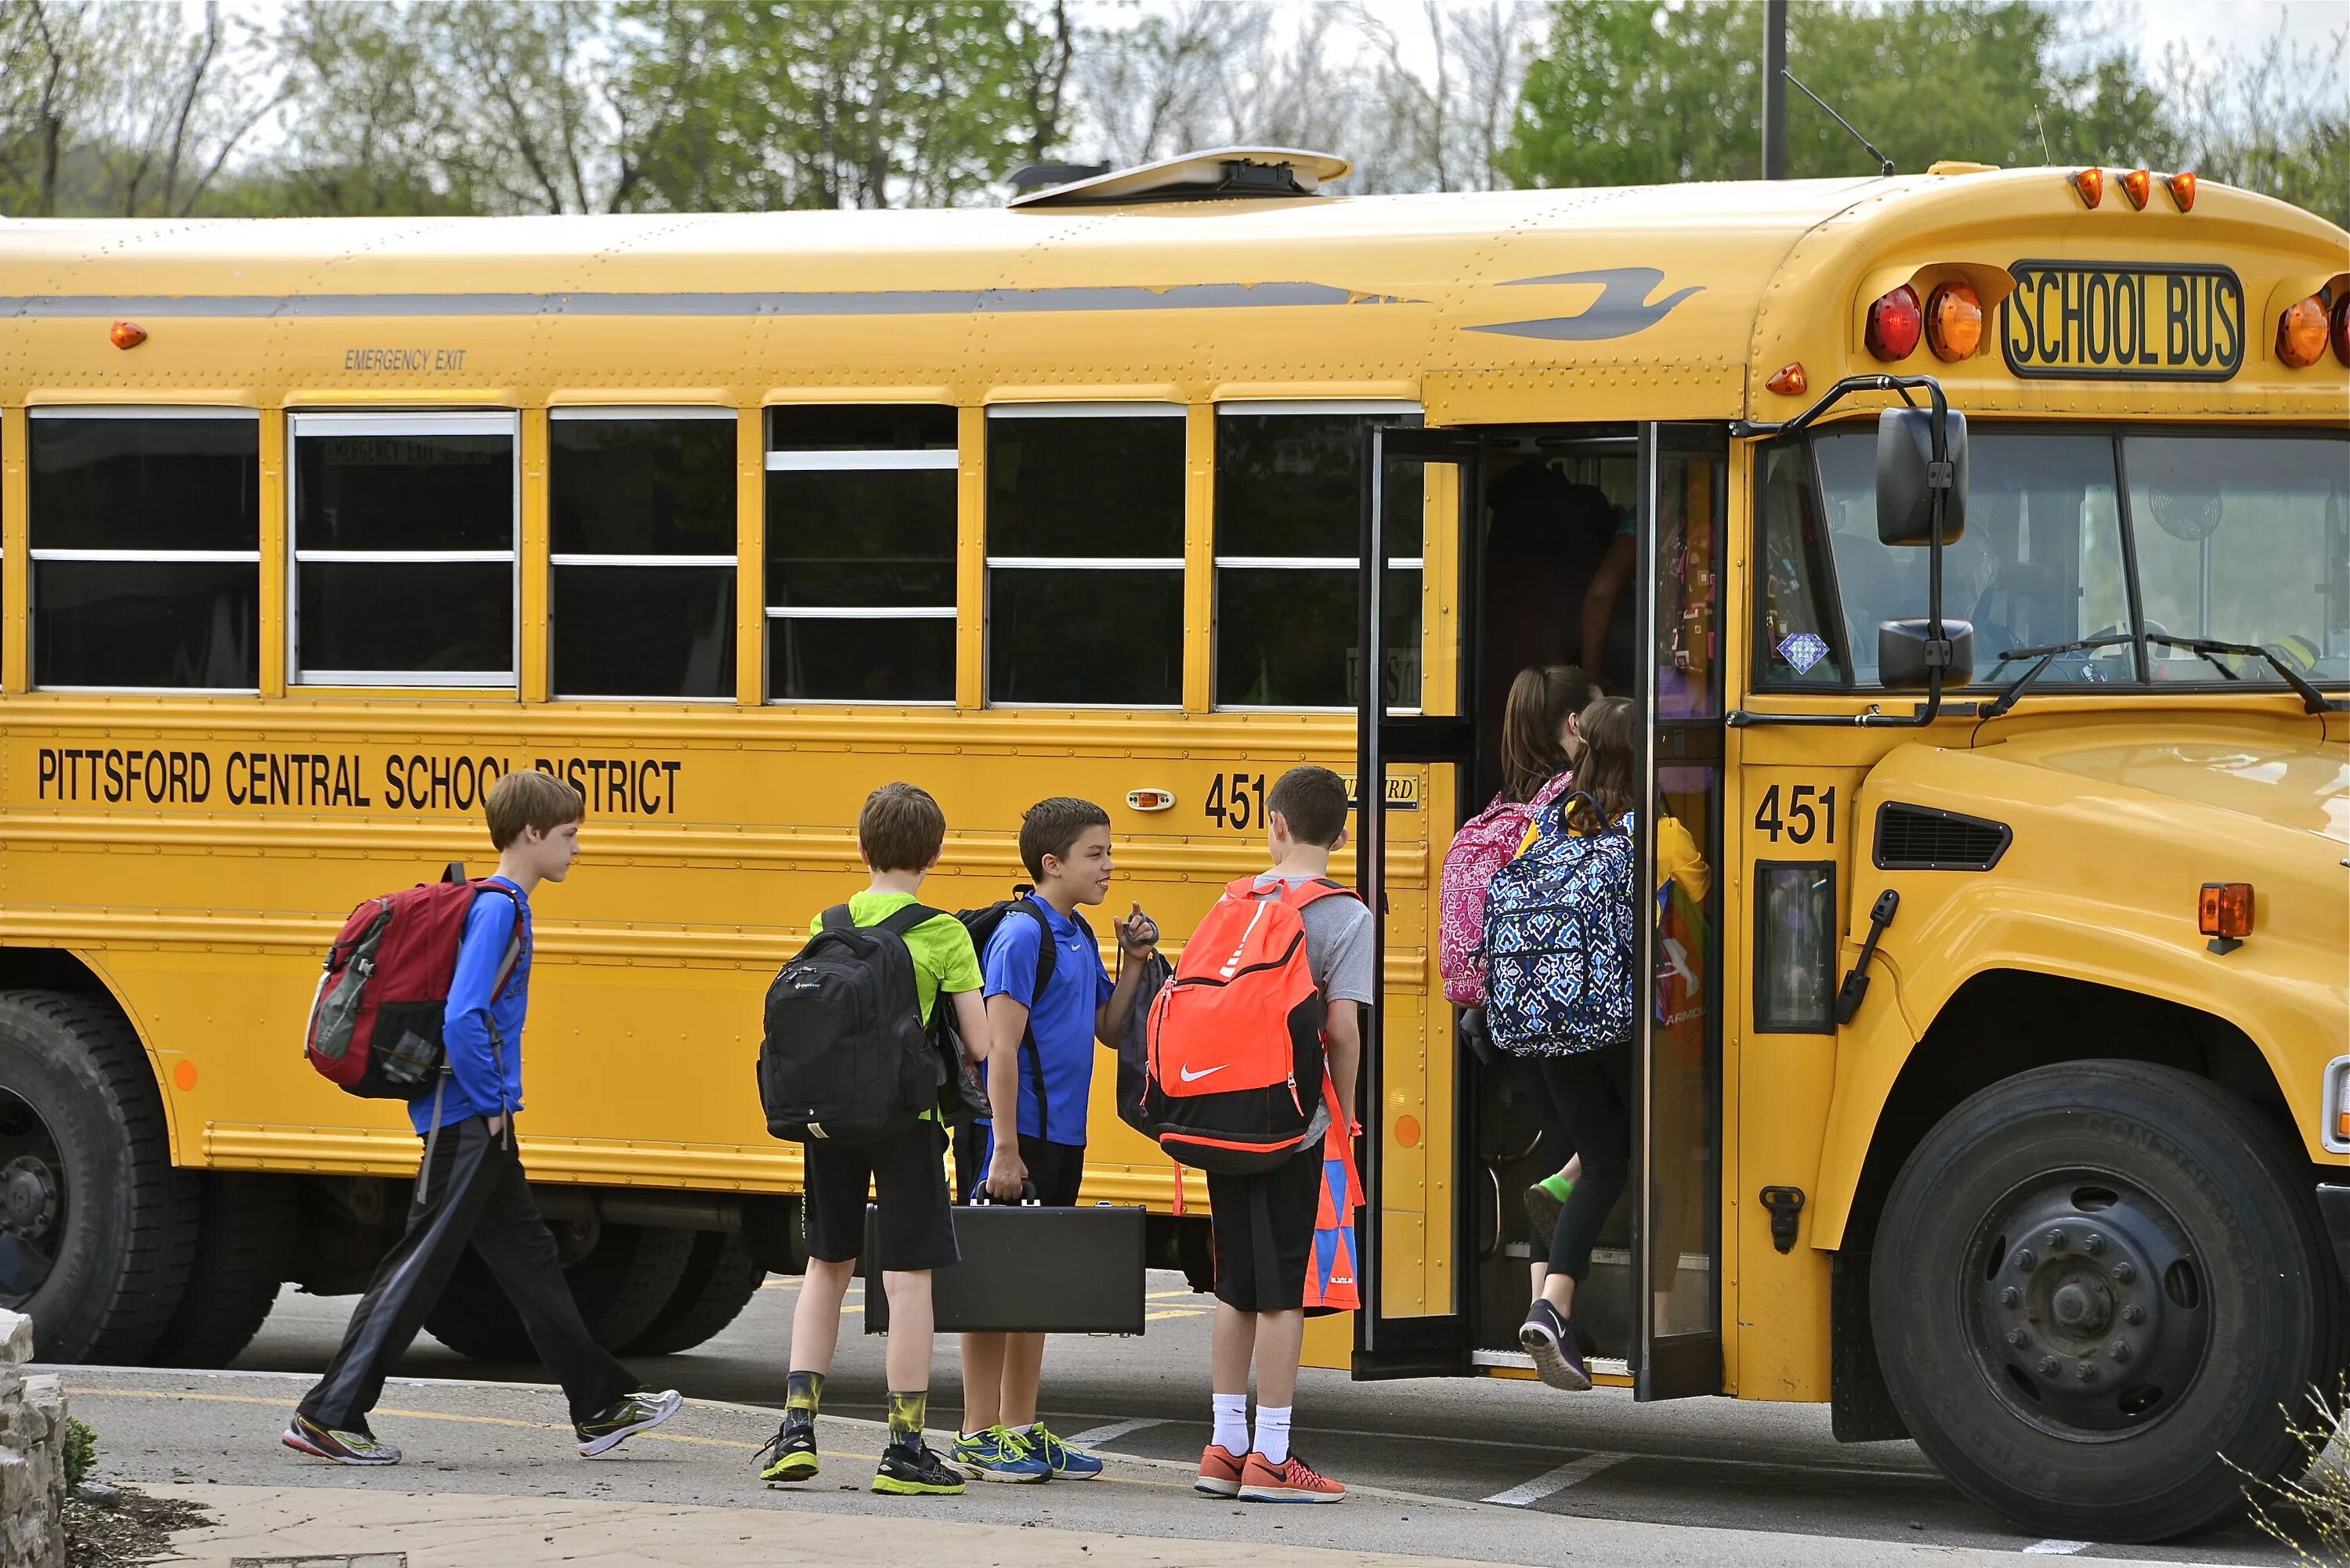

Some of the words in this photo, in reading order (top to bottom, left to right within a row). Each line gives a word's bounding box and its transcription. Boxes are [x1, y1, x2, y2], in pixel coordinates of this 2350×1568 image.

[2010, 273, 2158, 364] SCHOOL
[2167, 275, 2237, 367] BUS
[345, 349, 431, 370] EMERGENCY
[436, 349, 466, 370] EXIT
[38, 749, 210, 804] PITTSFORD
[226, 751, 371, 807] CENTRAL
[385, 754, 508, 811] SCHOO
[1205, 773, 1265, 830] 451
[1755, 784, 1835, 844] 451
[1665, 1003, 1707, 1027] ARMOU
